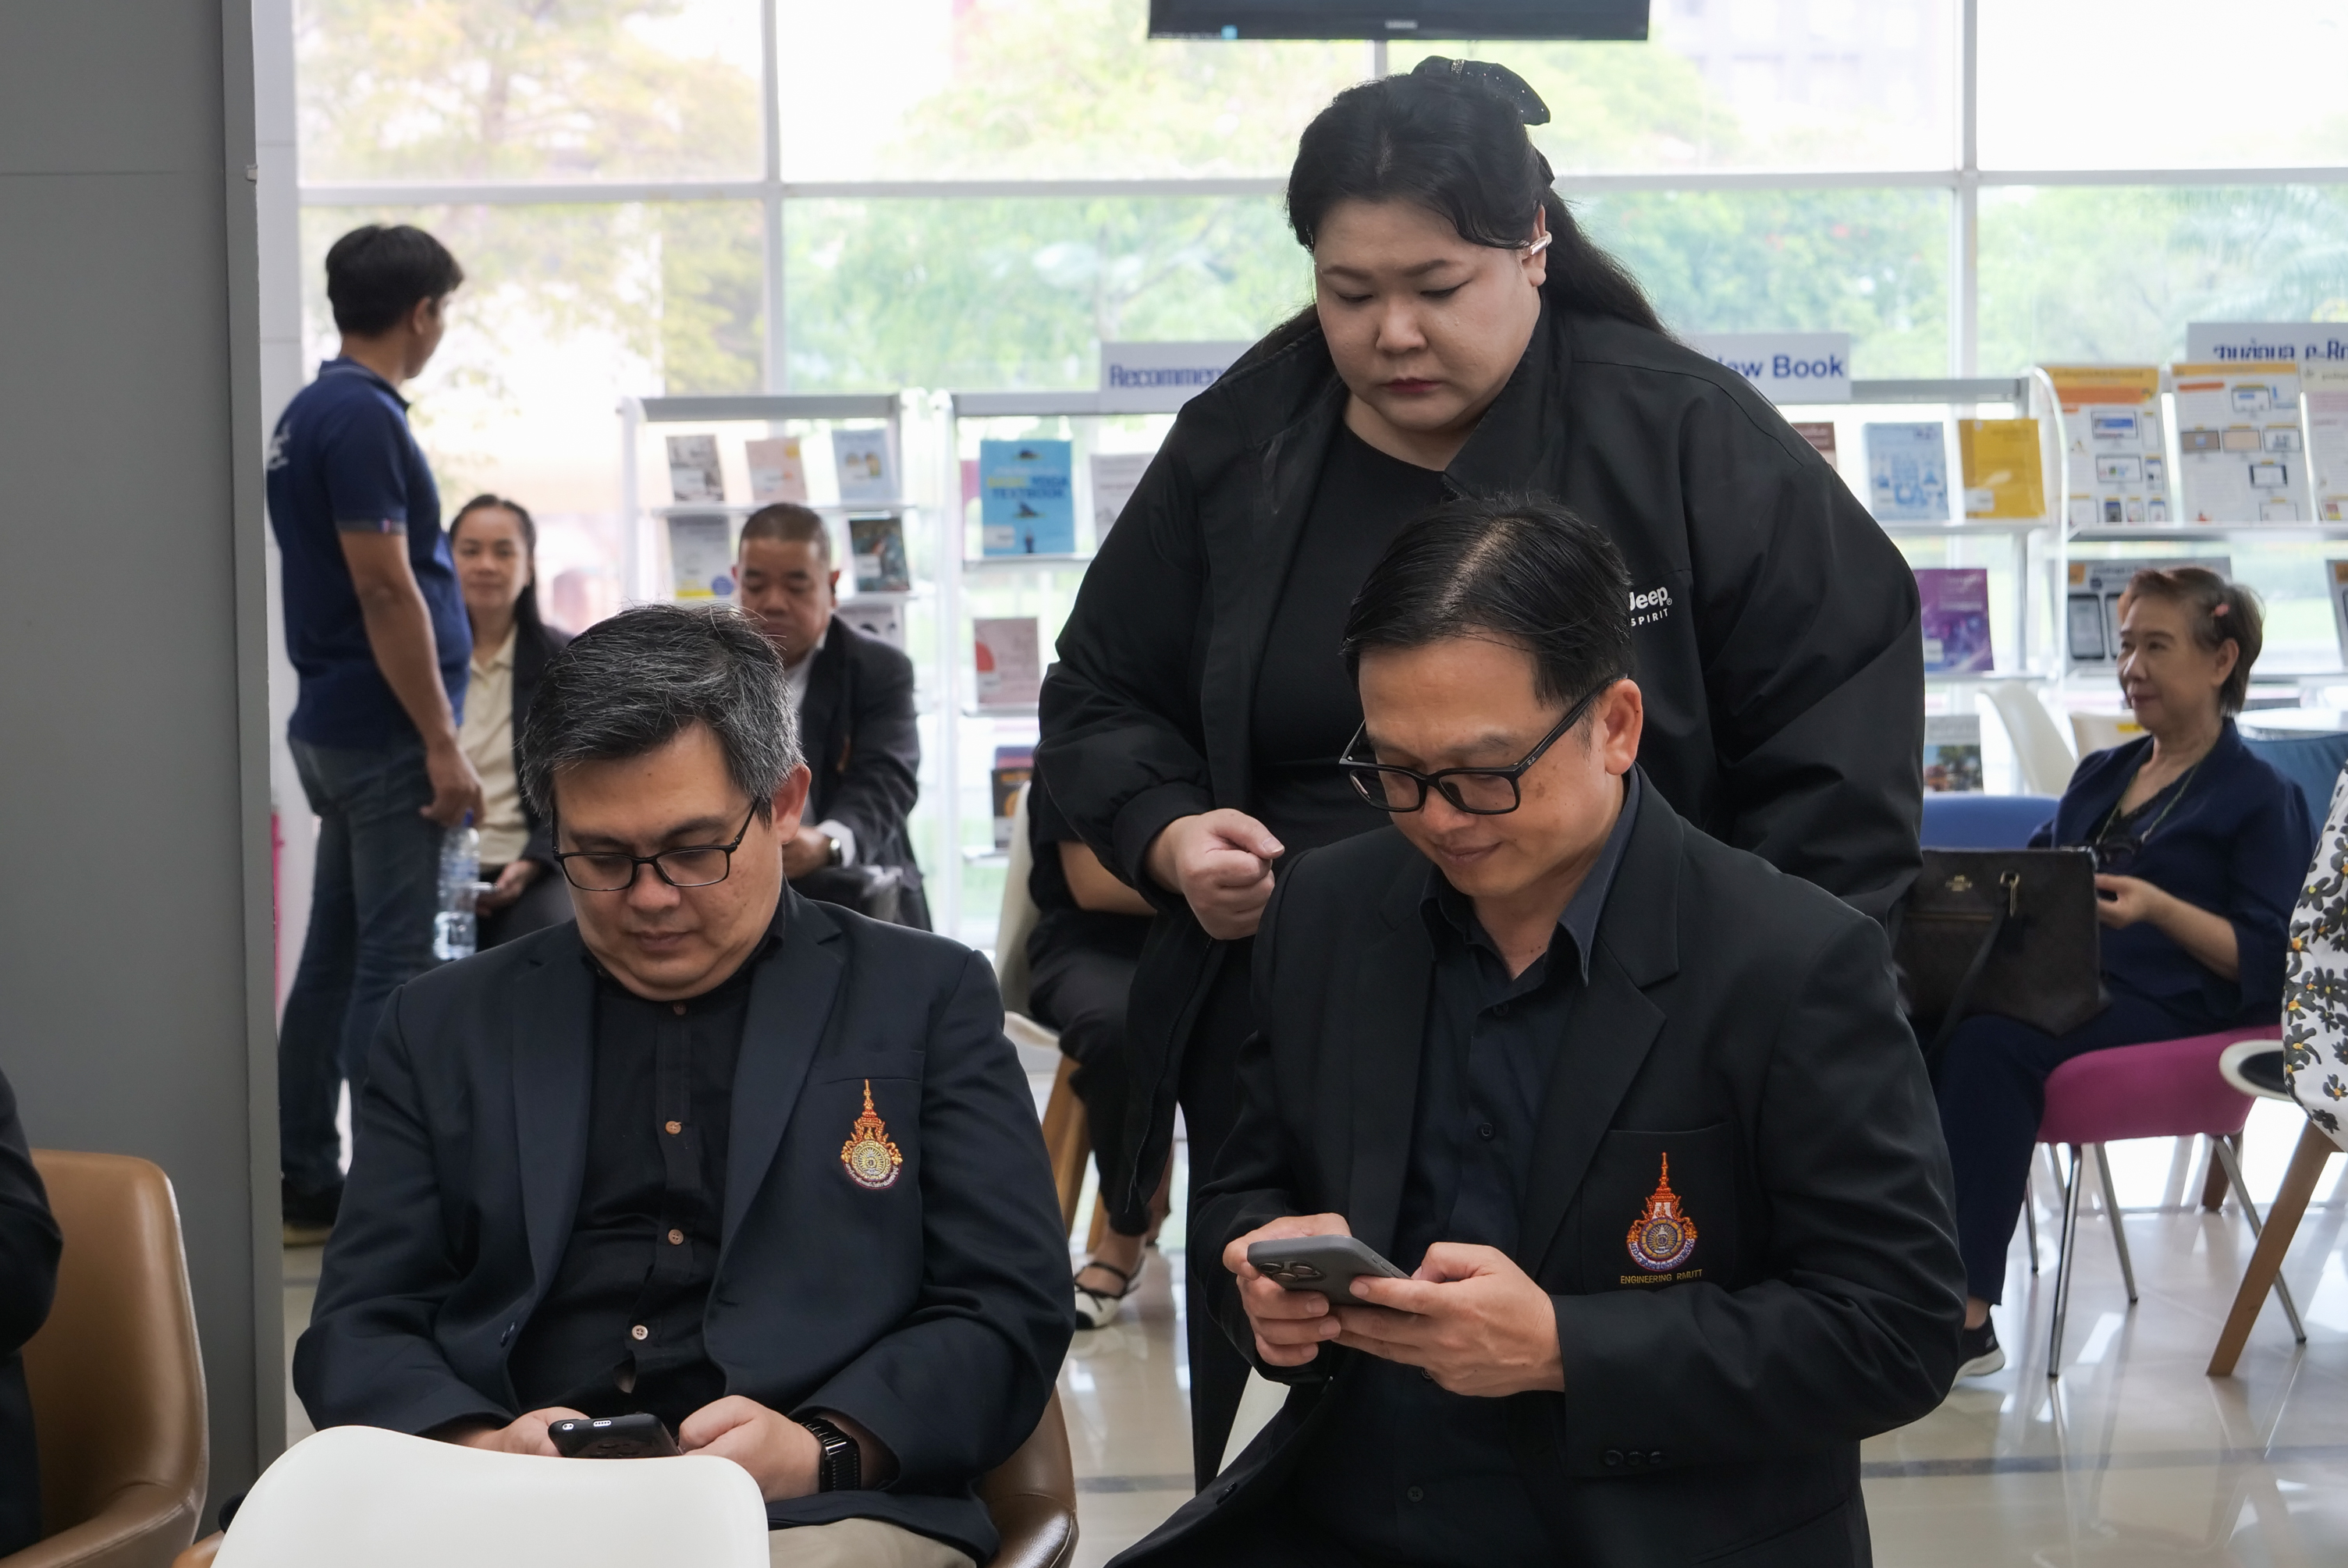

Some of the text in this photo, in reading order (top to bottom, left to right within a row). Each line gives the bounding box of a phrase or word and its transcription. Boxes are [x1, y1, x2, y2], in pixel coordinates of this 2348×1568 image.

[1774, 354, 1843, 378] Book
[1631, 608, 1668, 626] SPIRIT
[1620, 1268, 1703, 1284] ENGINEERING RMUTT
